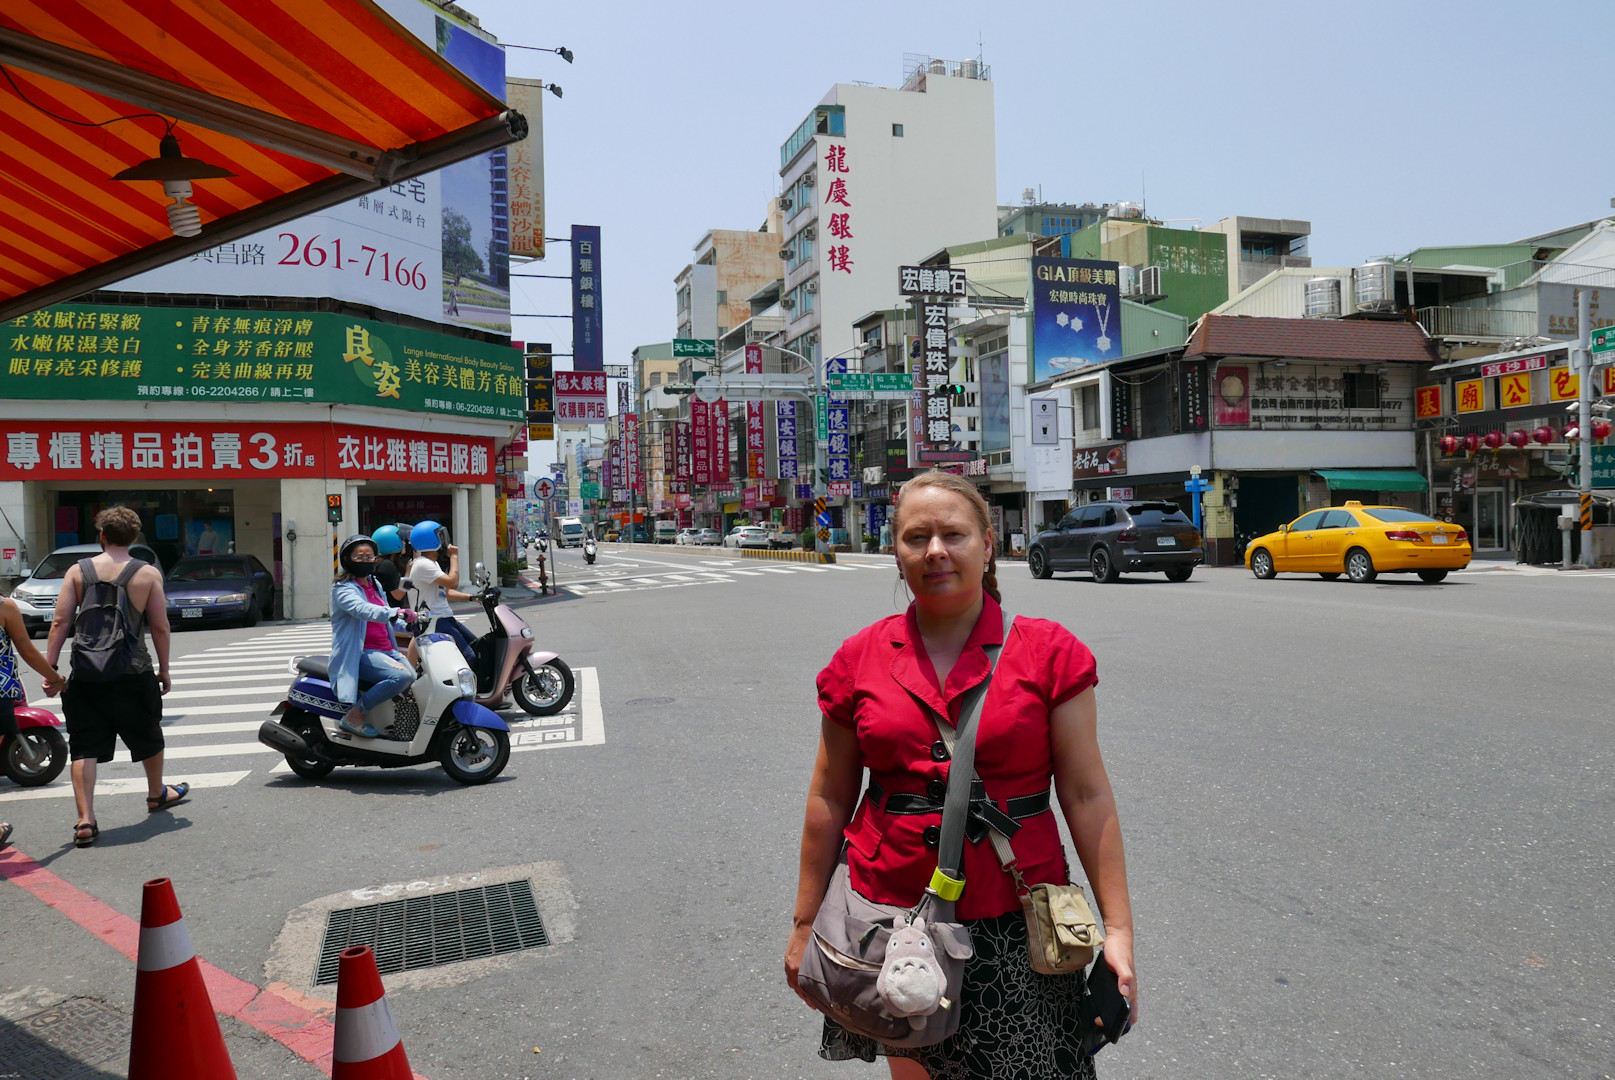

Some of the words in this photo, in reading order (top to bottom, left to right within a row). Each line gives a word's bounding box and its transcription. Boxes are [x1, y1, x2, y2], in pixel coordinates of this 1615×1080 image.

[824, 145, 854, 274] 龍慶銀樓
[277, 233, 427, 291] 261-7166
[579, 240, 594, 309] 百雅銀樓
[902, 268, 966, 295] 宏偉鑽石
[1037, 264, 1067, 282] GIA
[1049, 289, 1107, 307] 宏偉時尚珠寶
[191, 316, 313, 336] 青春無痕淨膚
[9, 334, 141, 354] 水嫩保濕美白
[191, 338, 314, 359] 全身芳香舒壓
[8, 358, 143, 378] 眼唇亮采修護
[342, 325, 402, 399] 良姿
[403, 345, 424, 358] Lange
[424, 348, 463, 365] International
[464, 356, 479, 370] Body
[479, 357, 498, 371] Beauty
[499, 361, 515, 373] Salon
[191, 361, 314, 381] 完美曲線再現
[404, 358, 524, 398] 美容美體芳香館
[876, 375, 910, 383] 和平街
[924, 305, 950, 442] 宏偉珠寶銀樓
[270, 387, 314, 398] 請上二樓
[557, 374, 606, 392] 福大銀樓
[558, 402, 606, 418] 收購專門店
[1420, 391, 1438, 416] 基
[337, 434, 488, 476] 衣比雅精品服飾
[1074, 450, 1099, 470] 老古石
[1112, 488, 1132, 500] 碗粿
